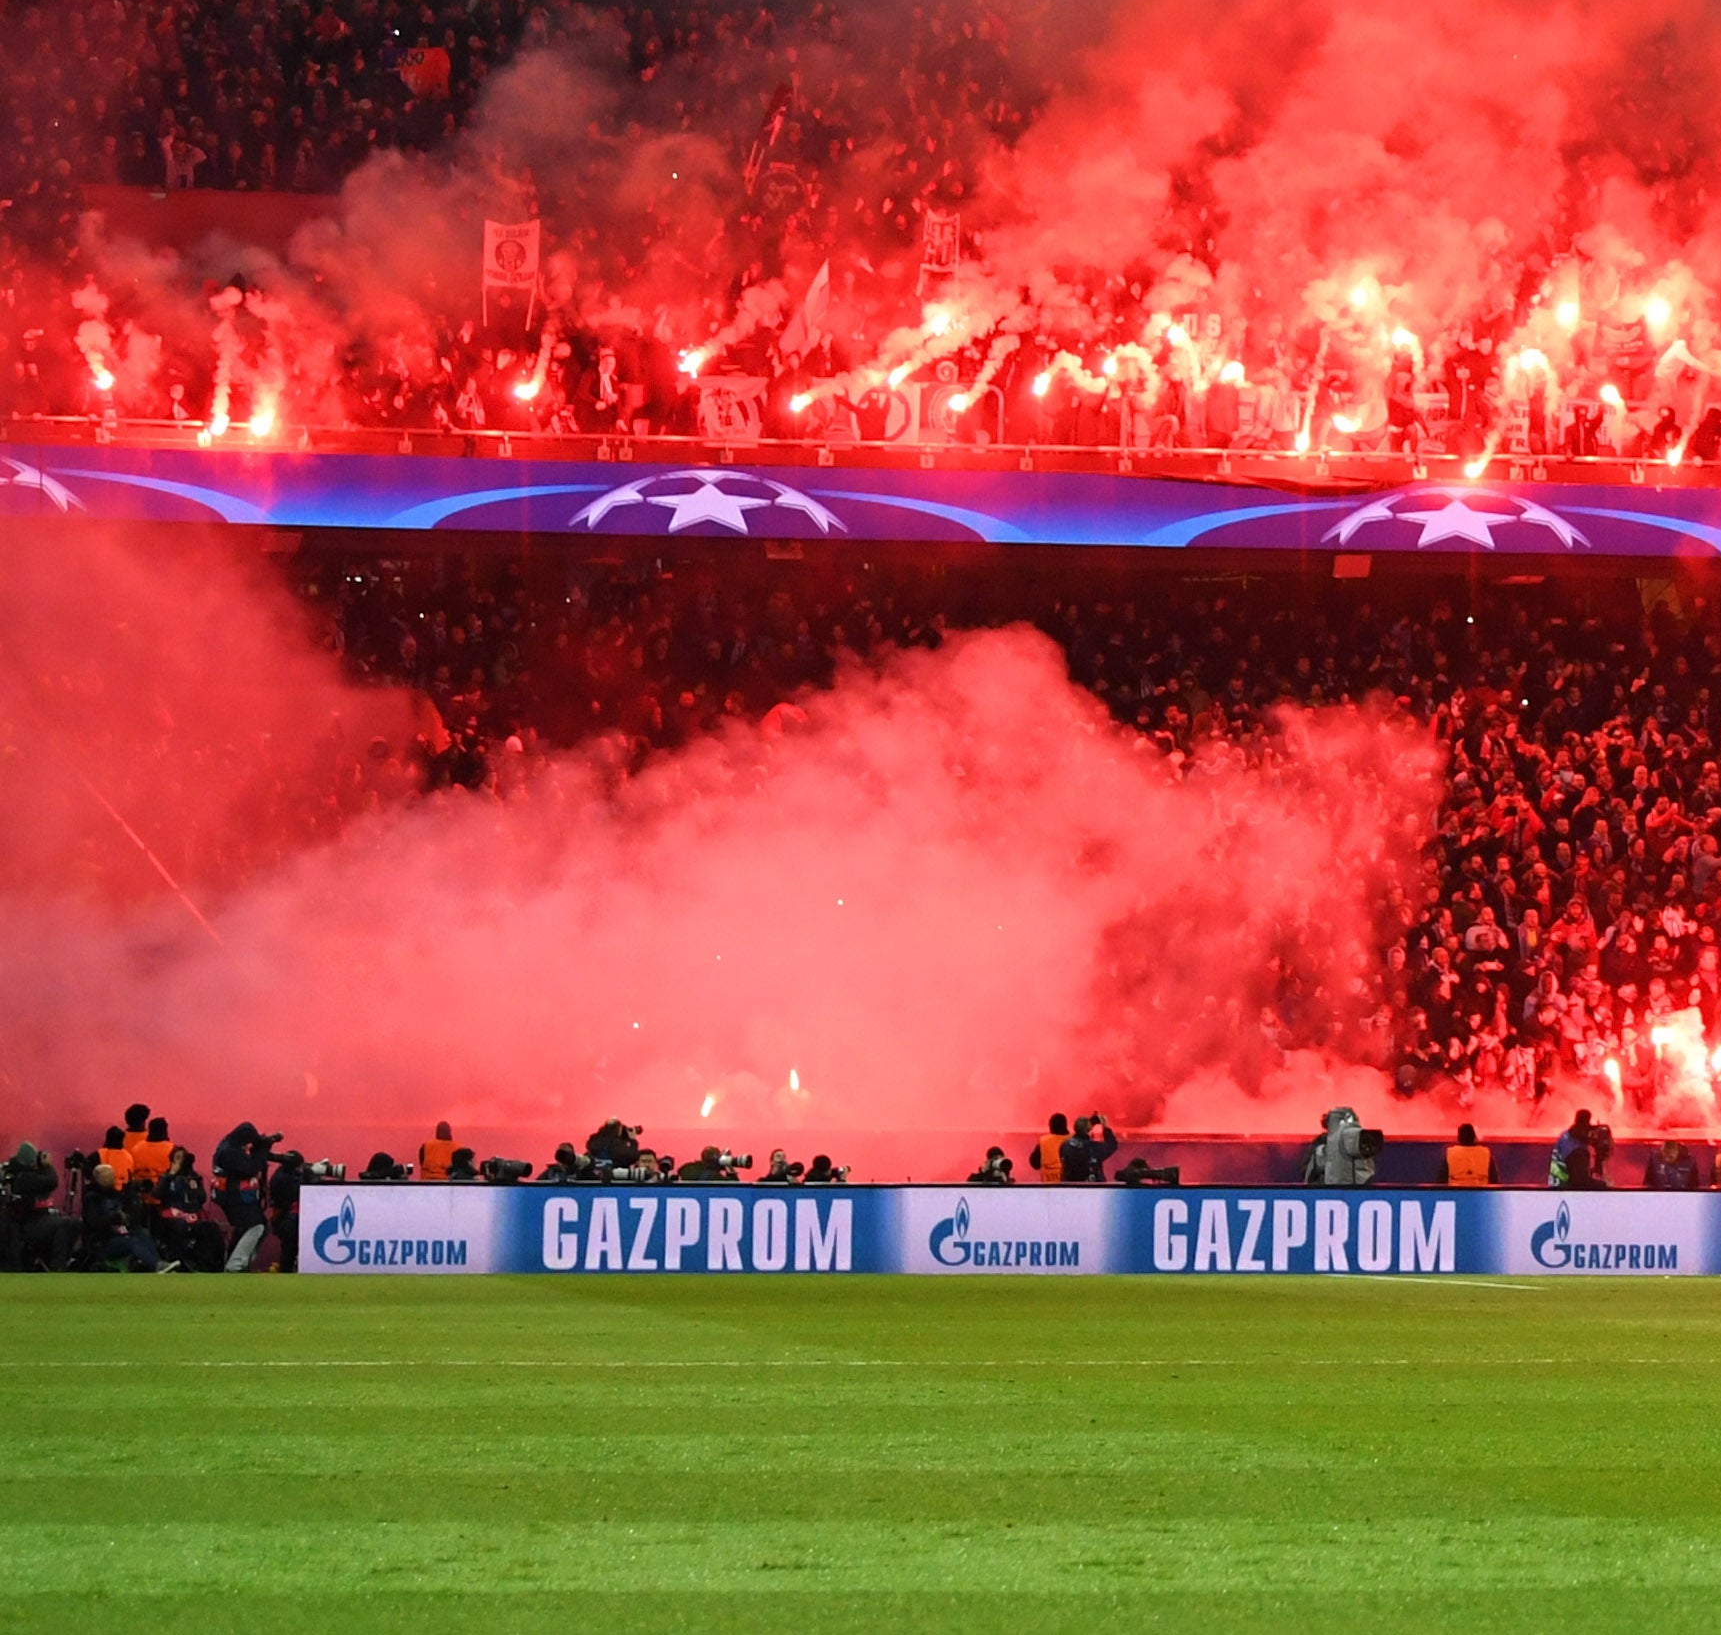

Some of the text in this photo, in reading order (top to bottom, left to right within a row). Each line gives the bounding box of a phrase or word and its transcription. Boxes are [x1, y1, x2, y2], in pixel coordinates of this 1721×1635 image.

[544, 1198, 852, 1270] GAZPROM
[1154, 1200, 1455, 1272] GAZPROM
[358, 1240, 467, 1266] GAZPROM
[974, 1241, 1079, 1266] GAZPROM
[1574, 1245, 1677, 1269] GAZPROM
